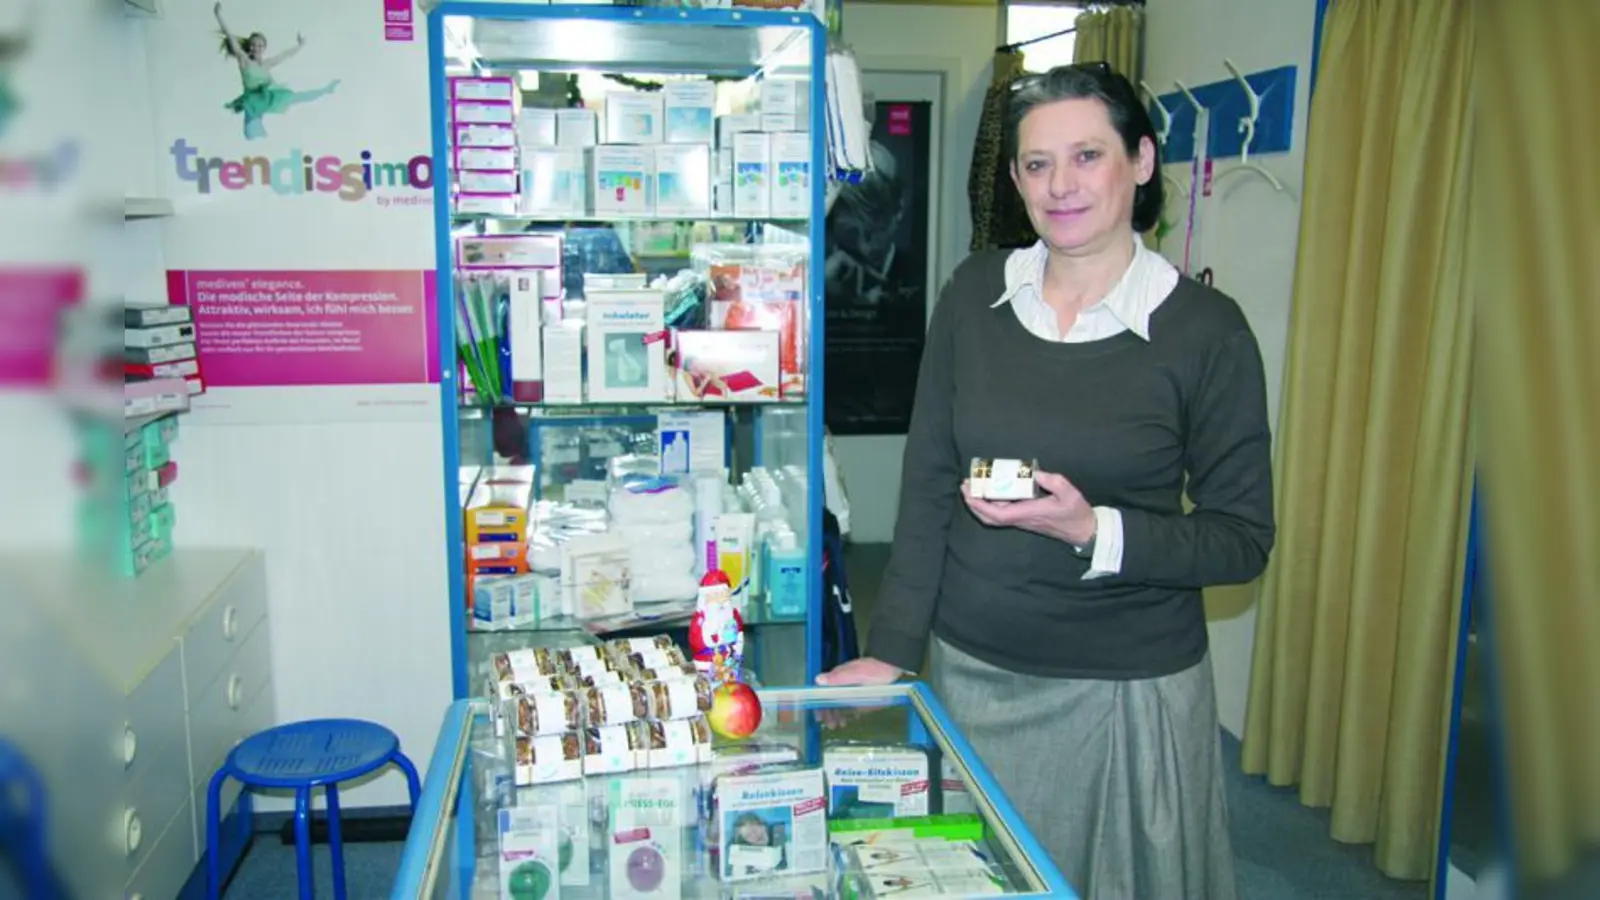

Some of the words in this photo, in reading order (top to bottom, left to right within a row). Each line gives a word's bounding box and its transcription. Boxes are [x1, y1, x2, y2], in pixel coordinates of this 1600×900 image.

[170, 138, 434, 202] trendissimo
[251, 279, 304, 291] elegance.
[197, 292, 216, 302] Die
[219, 291, 273, 302] modische
[275, 291, 302, 302] Seite
[304, 291, 323, 301] der
[325, 291, 398, 303] Kompression.
[198, 304, 252, 315] Attraktiv,
[254, 304, 304, 316] wirksam,
[307, 303, 323, 314] ich
[325, 303, 347, 314] fühl
[349, 303, 376, 314] mich
